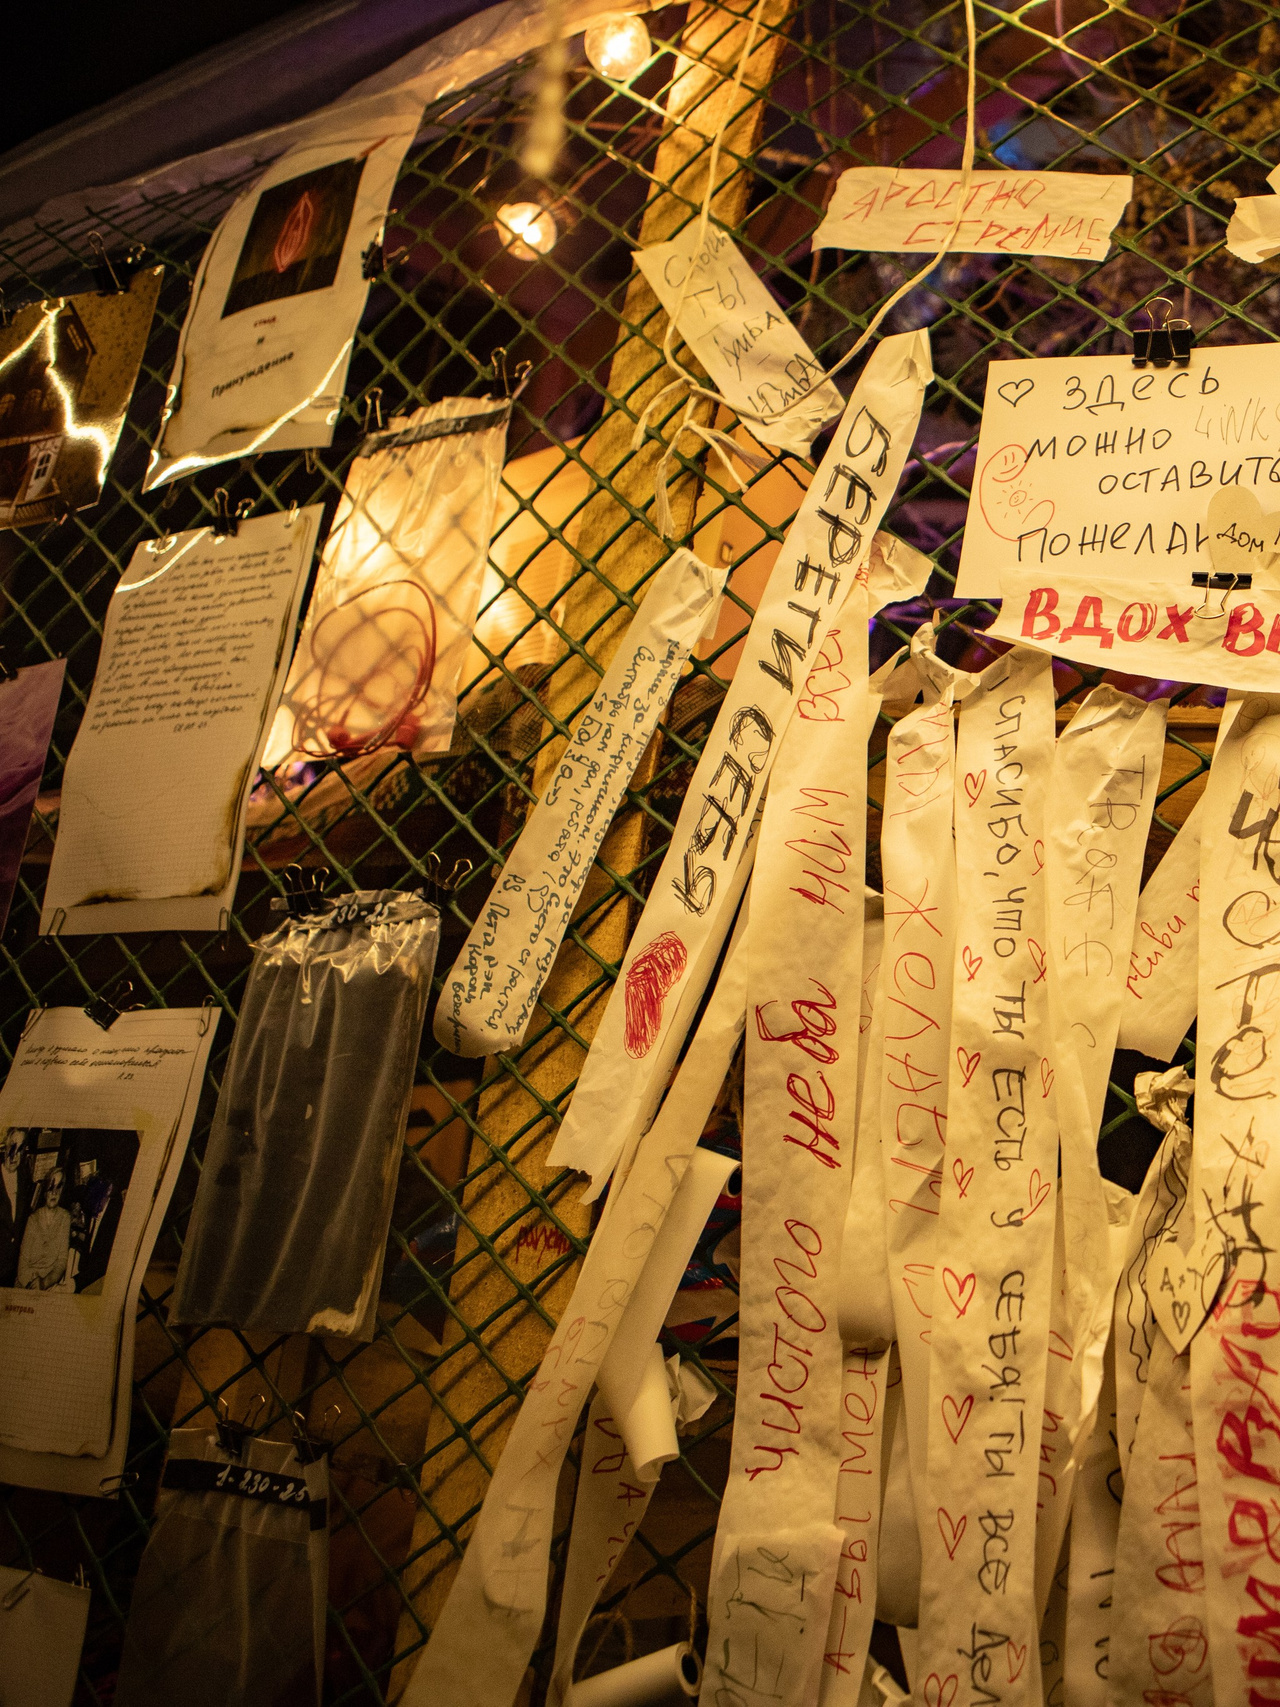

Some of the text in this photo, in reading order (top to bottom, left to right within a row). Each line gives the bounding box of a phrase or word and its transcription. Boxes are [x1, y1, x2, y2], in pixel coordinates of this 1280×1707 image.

[844, 177, 1045, 222] ЯРОСТНО
[211, 351, 294, 399] Принуждение
[1063, 366, 1220, 416] ЗДЕСЬ
[1024, 427, 1172, 462] МОЖНО
[759, 406, 891, 697] БЕРЕГИ
[1020, 587, 1195, 649] ВДОХ
[672, 703, 776, 918] СЕБЯ
[984, 693, 1027, 879] СПАСИБО,
[992, 884, 1027, 960] ЧТО
[992, 979, 1027, 1042] ТЫ
[992, 1065, 1027, 1172] ЕСТЬ
[977, 1507, 1018, 1597] ВСЕ
